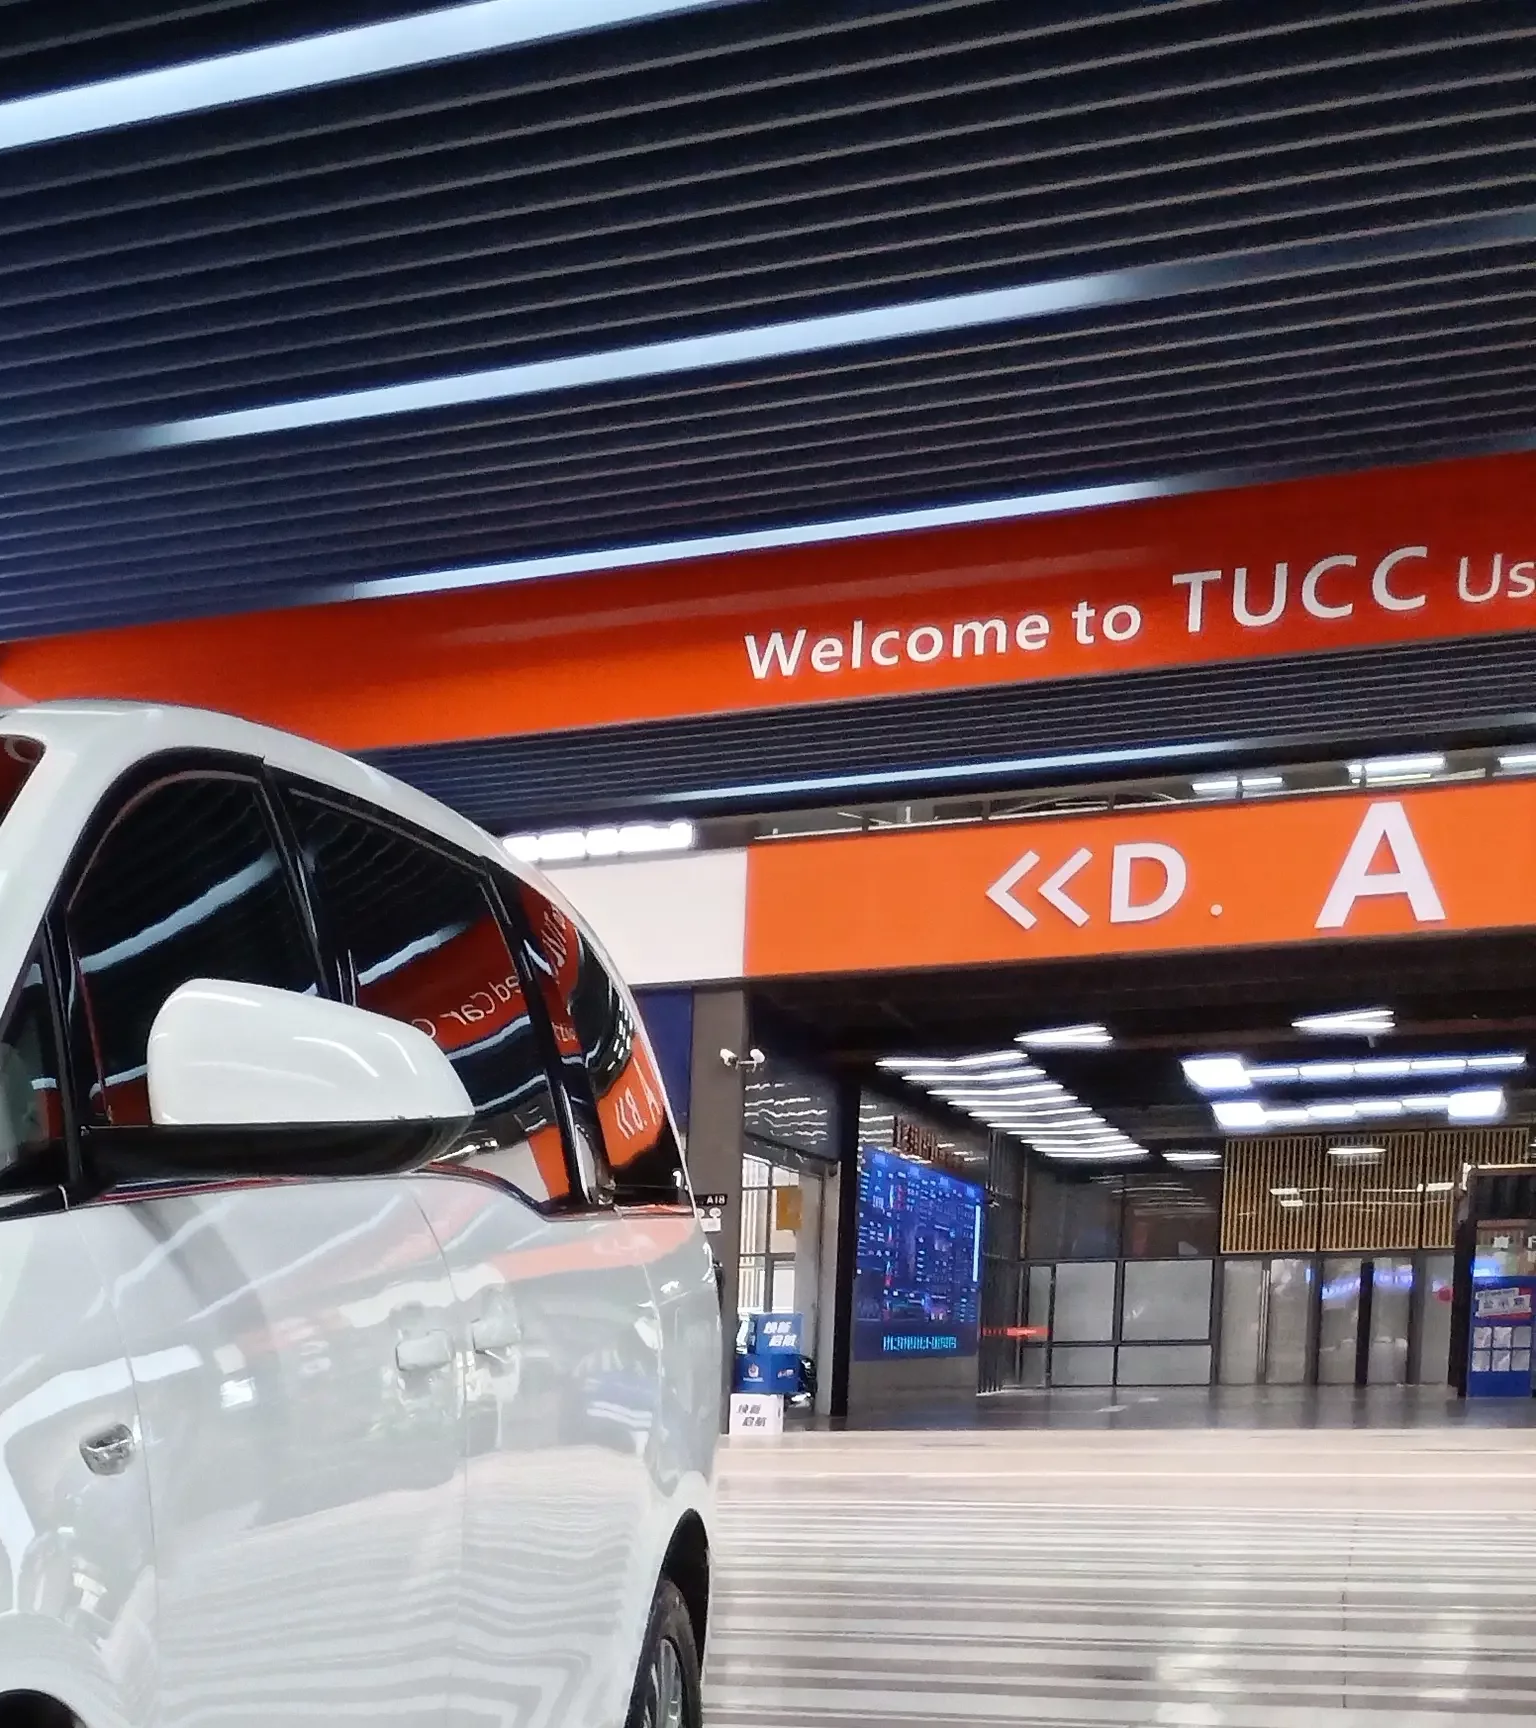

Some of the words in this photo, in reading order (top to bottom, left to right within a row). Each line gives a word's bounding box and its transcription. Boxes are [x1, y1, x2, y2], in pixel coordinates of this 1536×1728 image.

[744, 613, 1050, 680] Welcome
[1071, 601, 1142, 645] to
[1172, 546, 1428, 633] TUCC
[1458, 553, 1535, 603] Us
[1315, 800, 1446, 929] A
